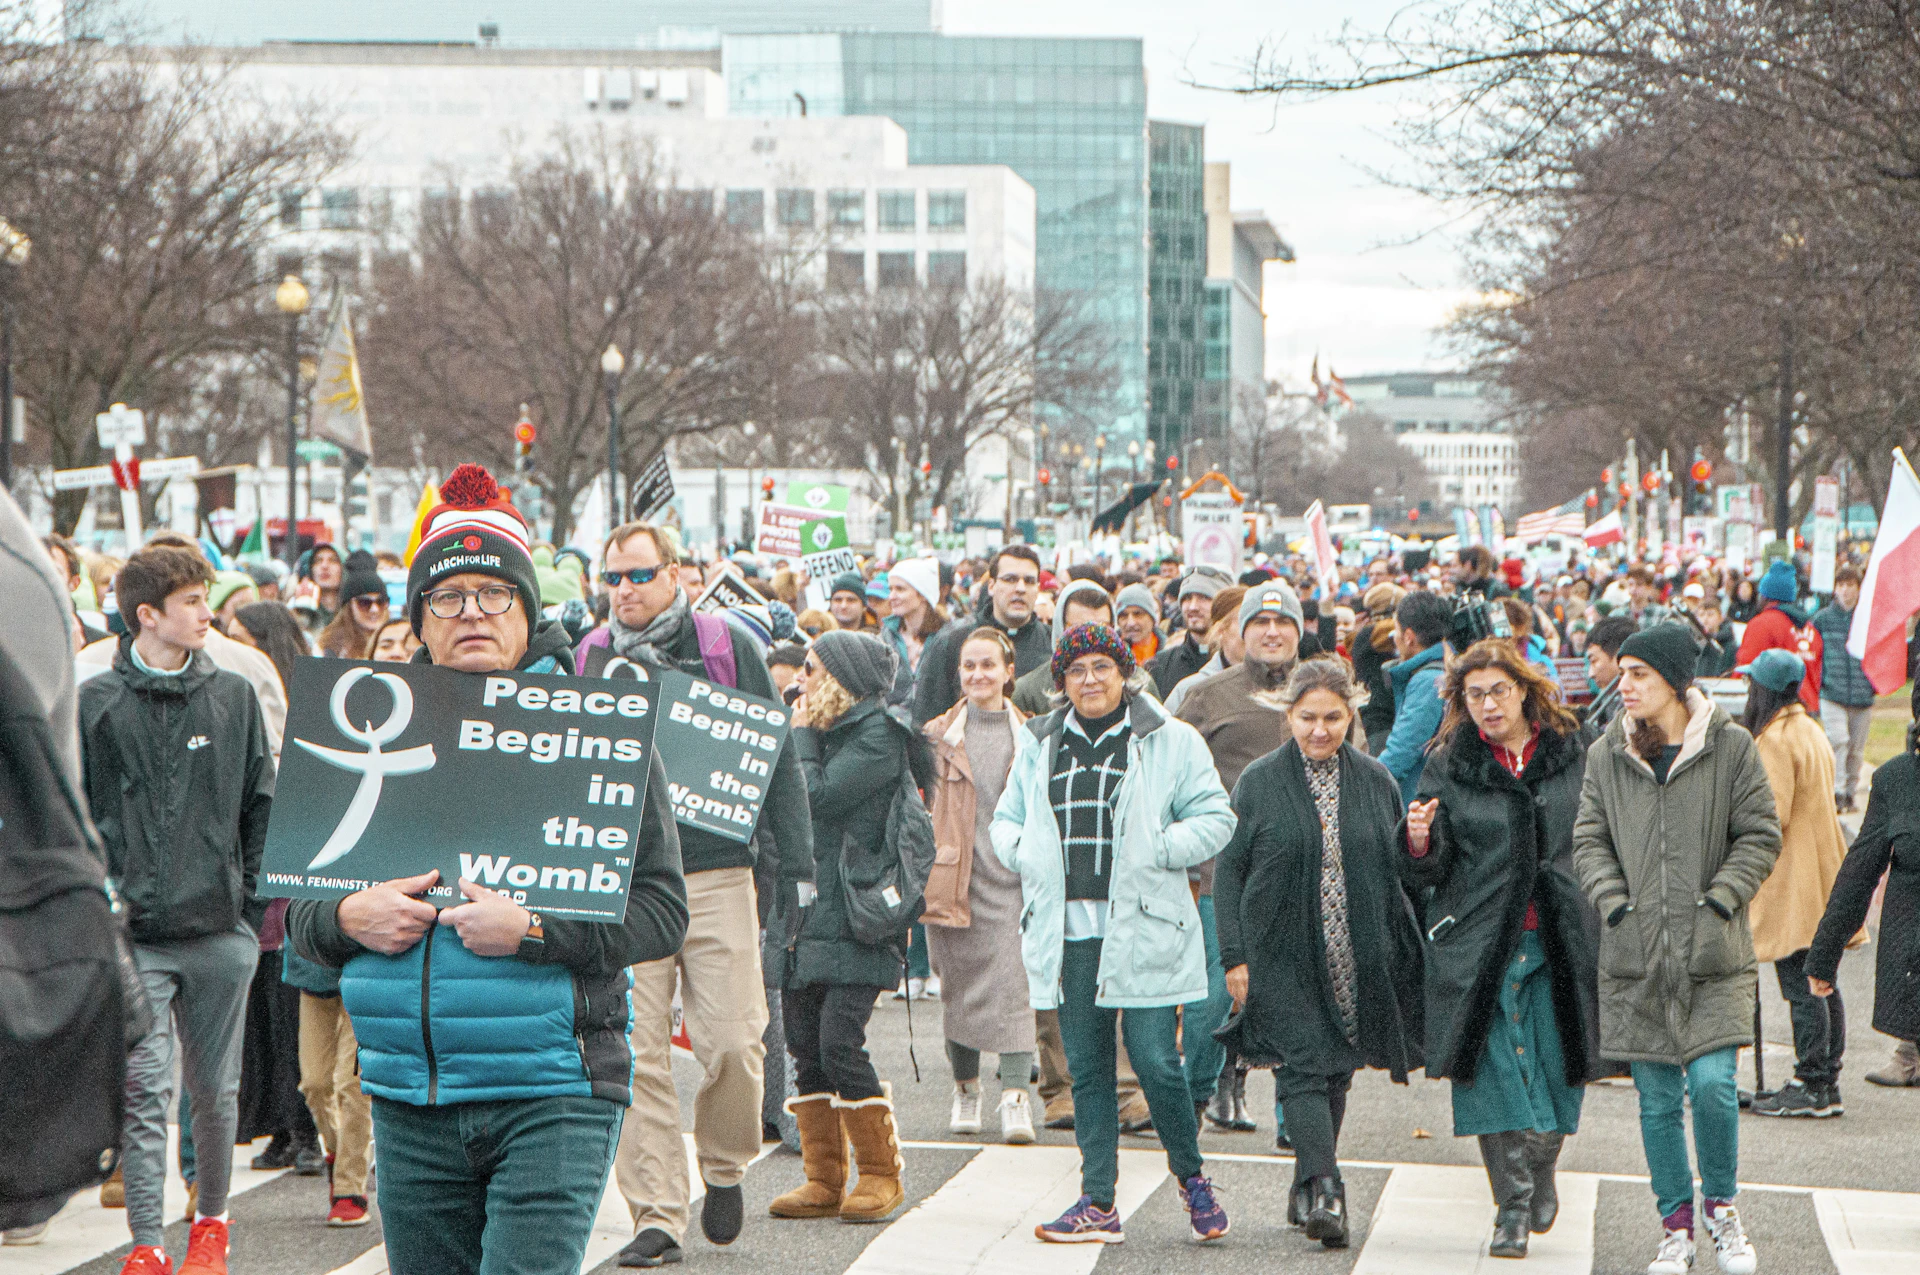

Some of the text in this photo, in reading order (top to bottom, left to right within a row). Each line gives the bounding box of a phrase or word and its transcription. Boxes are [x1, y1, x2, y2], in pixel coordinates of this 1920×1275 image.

[429, 553, 501, 578] MARCH FOR LIFE
[804, 551, 855, 579] DEFEND
[483, 676, 649, 718] Peace
[688, 680, 786, 727] Peace
[458, 719, 643, 764] Begins
[669, 701, 778, 752] Begins
[739, 751, 769, 777] in
[587, 774, 636, 807] in
[710, 770, 761, 800] the
[542, 816, 629, 850] the
[307, 876, 369, 891] FEMINISTS
[459, 853, 624, 895] Womb.
